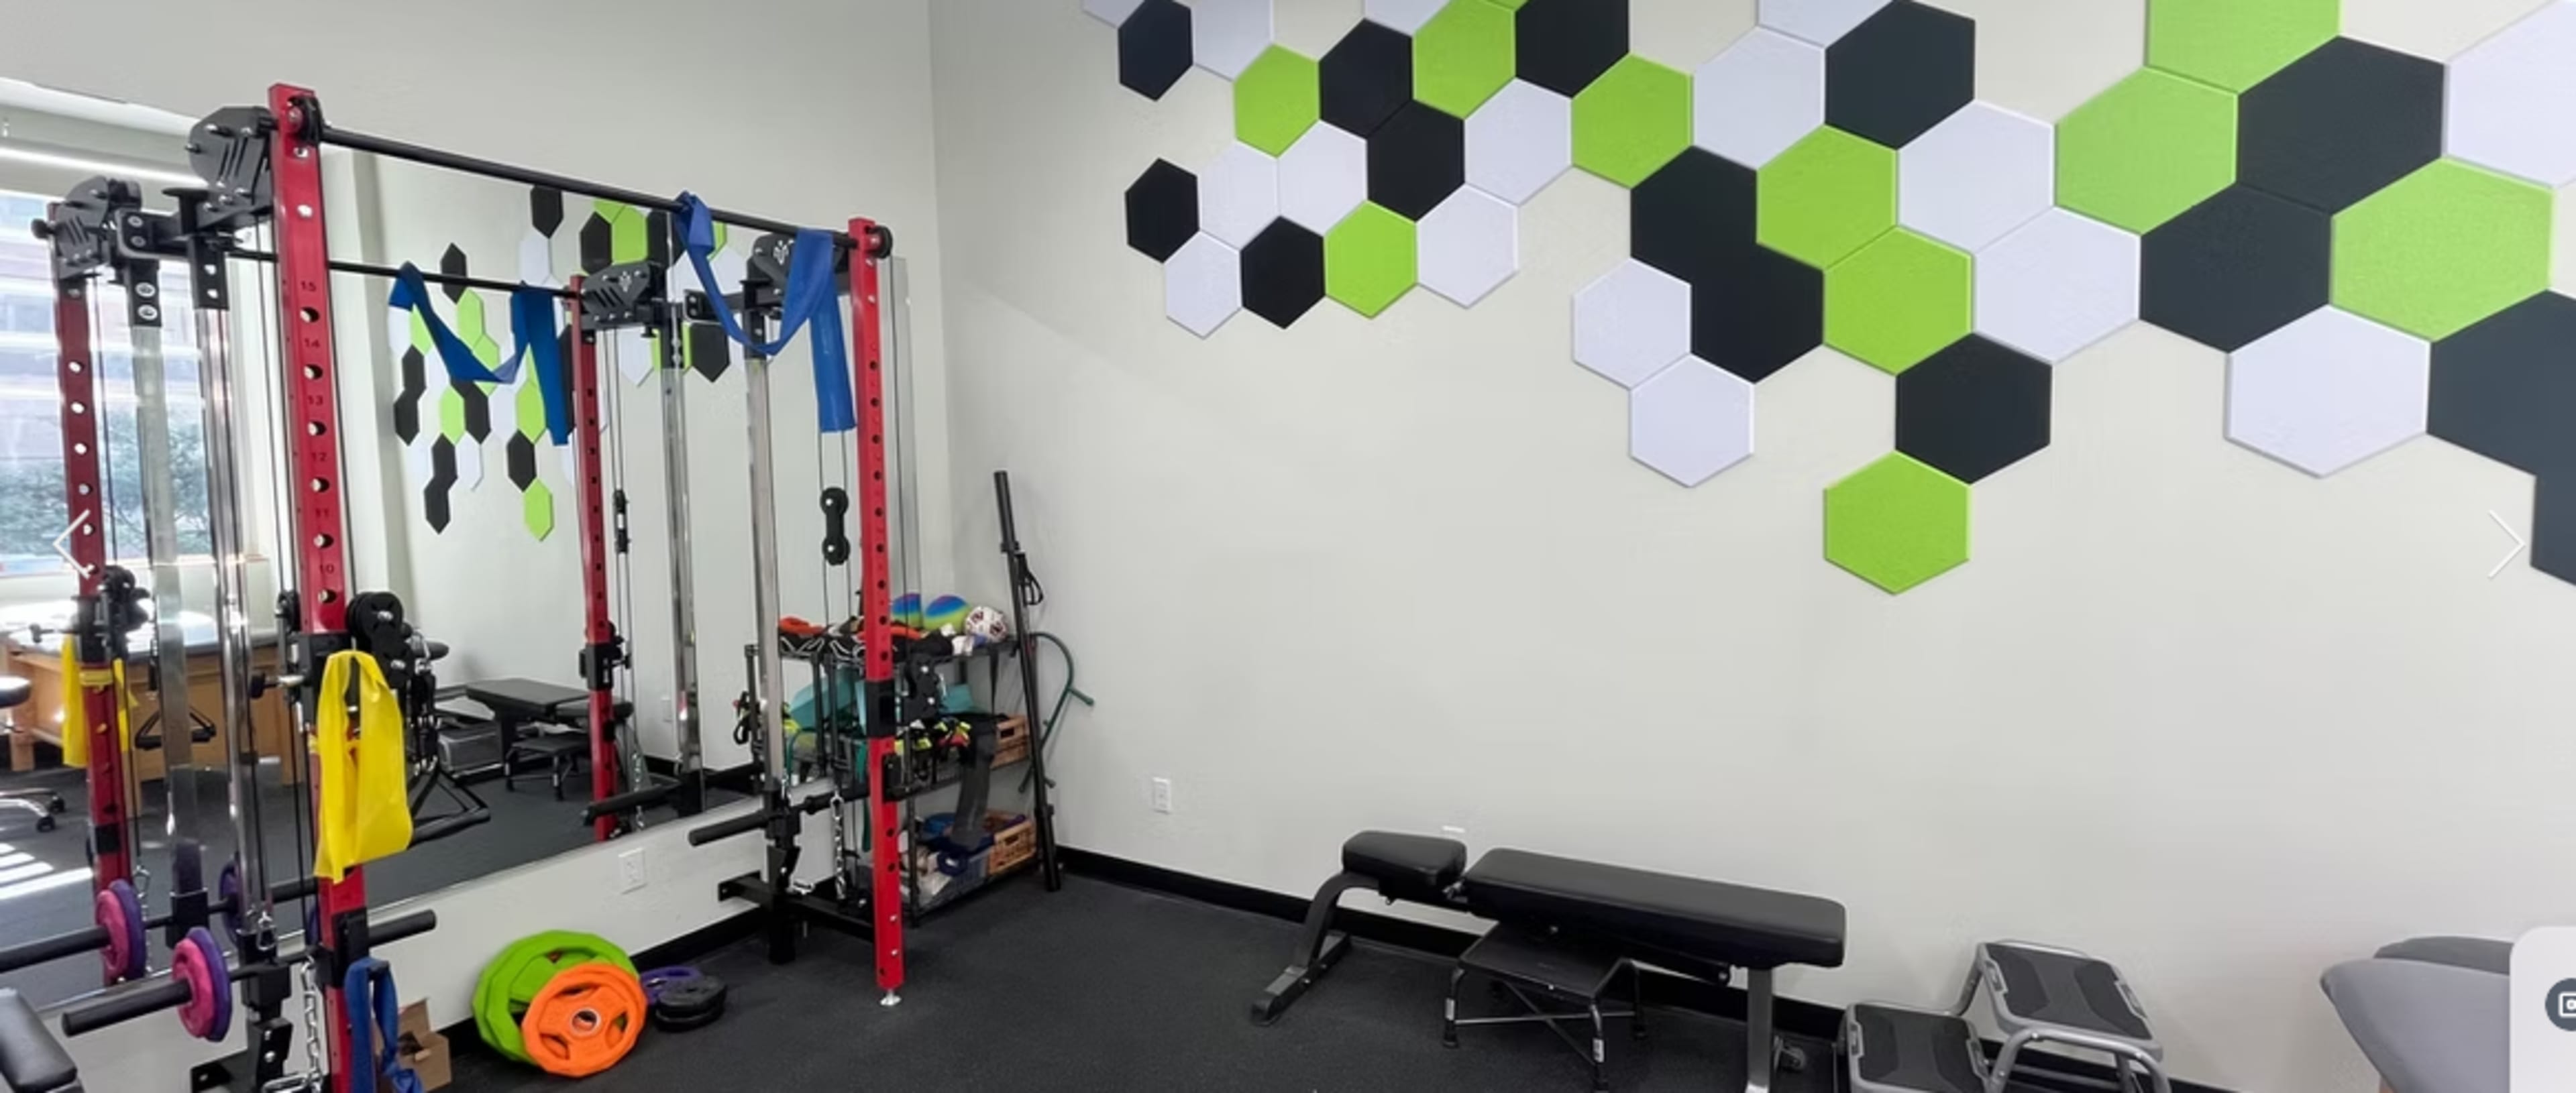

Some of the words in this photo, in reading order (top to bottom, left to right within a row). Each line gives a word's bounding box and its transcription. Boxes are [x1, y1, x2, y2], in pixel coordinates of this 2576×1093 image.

[301, 280, 317, 292] 15
[305, 338, 320, 348] 14
[308, 395, 323, 406] 13
[311, 451, 327, 462] 12
[315, 508, 329, 518] 11
[319, 564, 335, 574] 10
